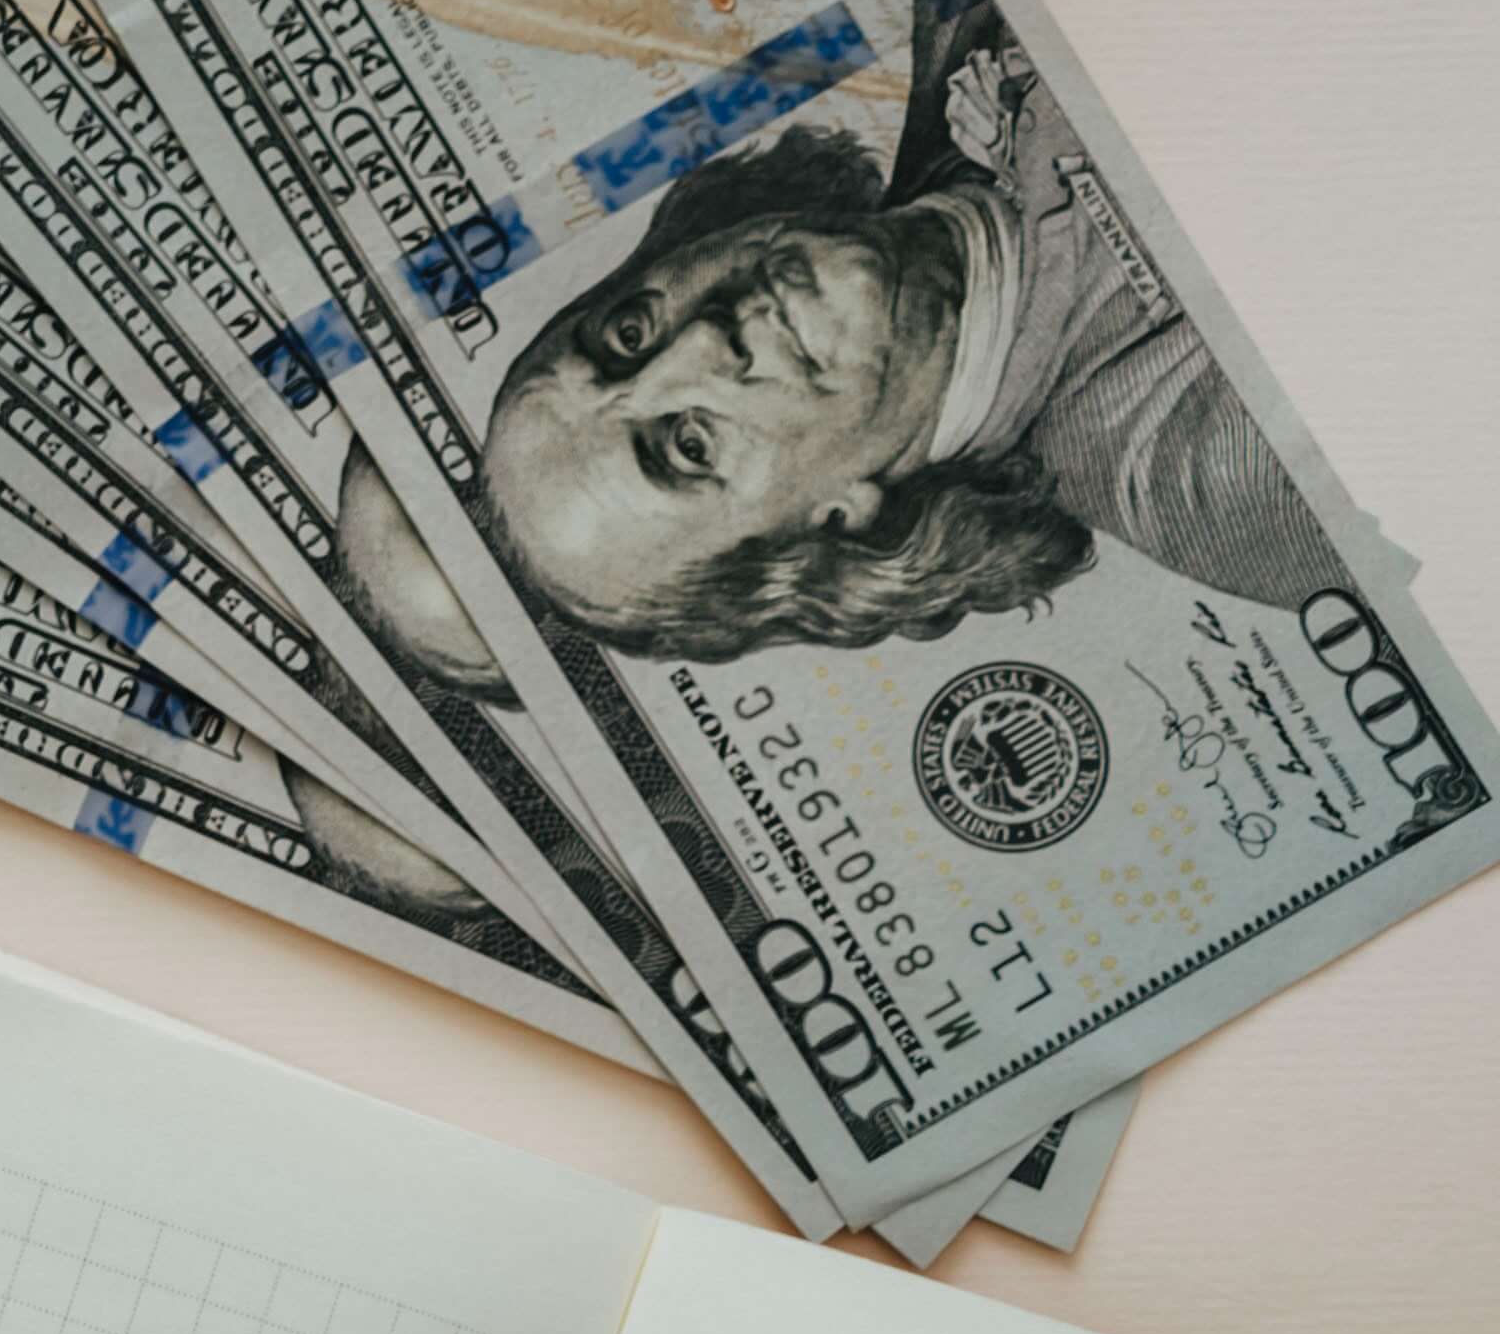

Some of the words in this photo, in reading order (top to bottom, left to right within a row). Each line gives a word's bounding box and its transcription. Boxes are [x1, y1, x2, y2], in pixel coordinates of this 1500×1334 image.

[669, 667, 739, 762] NOTE
[733, 685, 775, 721] C
[1298, 586, 1452, 800] 100
[728, 760, 839, 922] RESERVE
[758, 723, 935, 978] 83801932
[756, 916, 915, 1130] 100
[832, 919, 935, 1077] FEDERAL
[925, 980, 982, 1052] ML
[964, 909, 1053, 1020] L12
